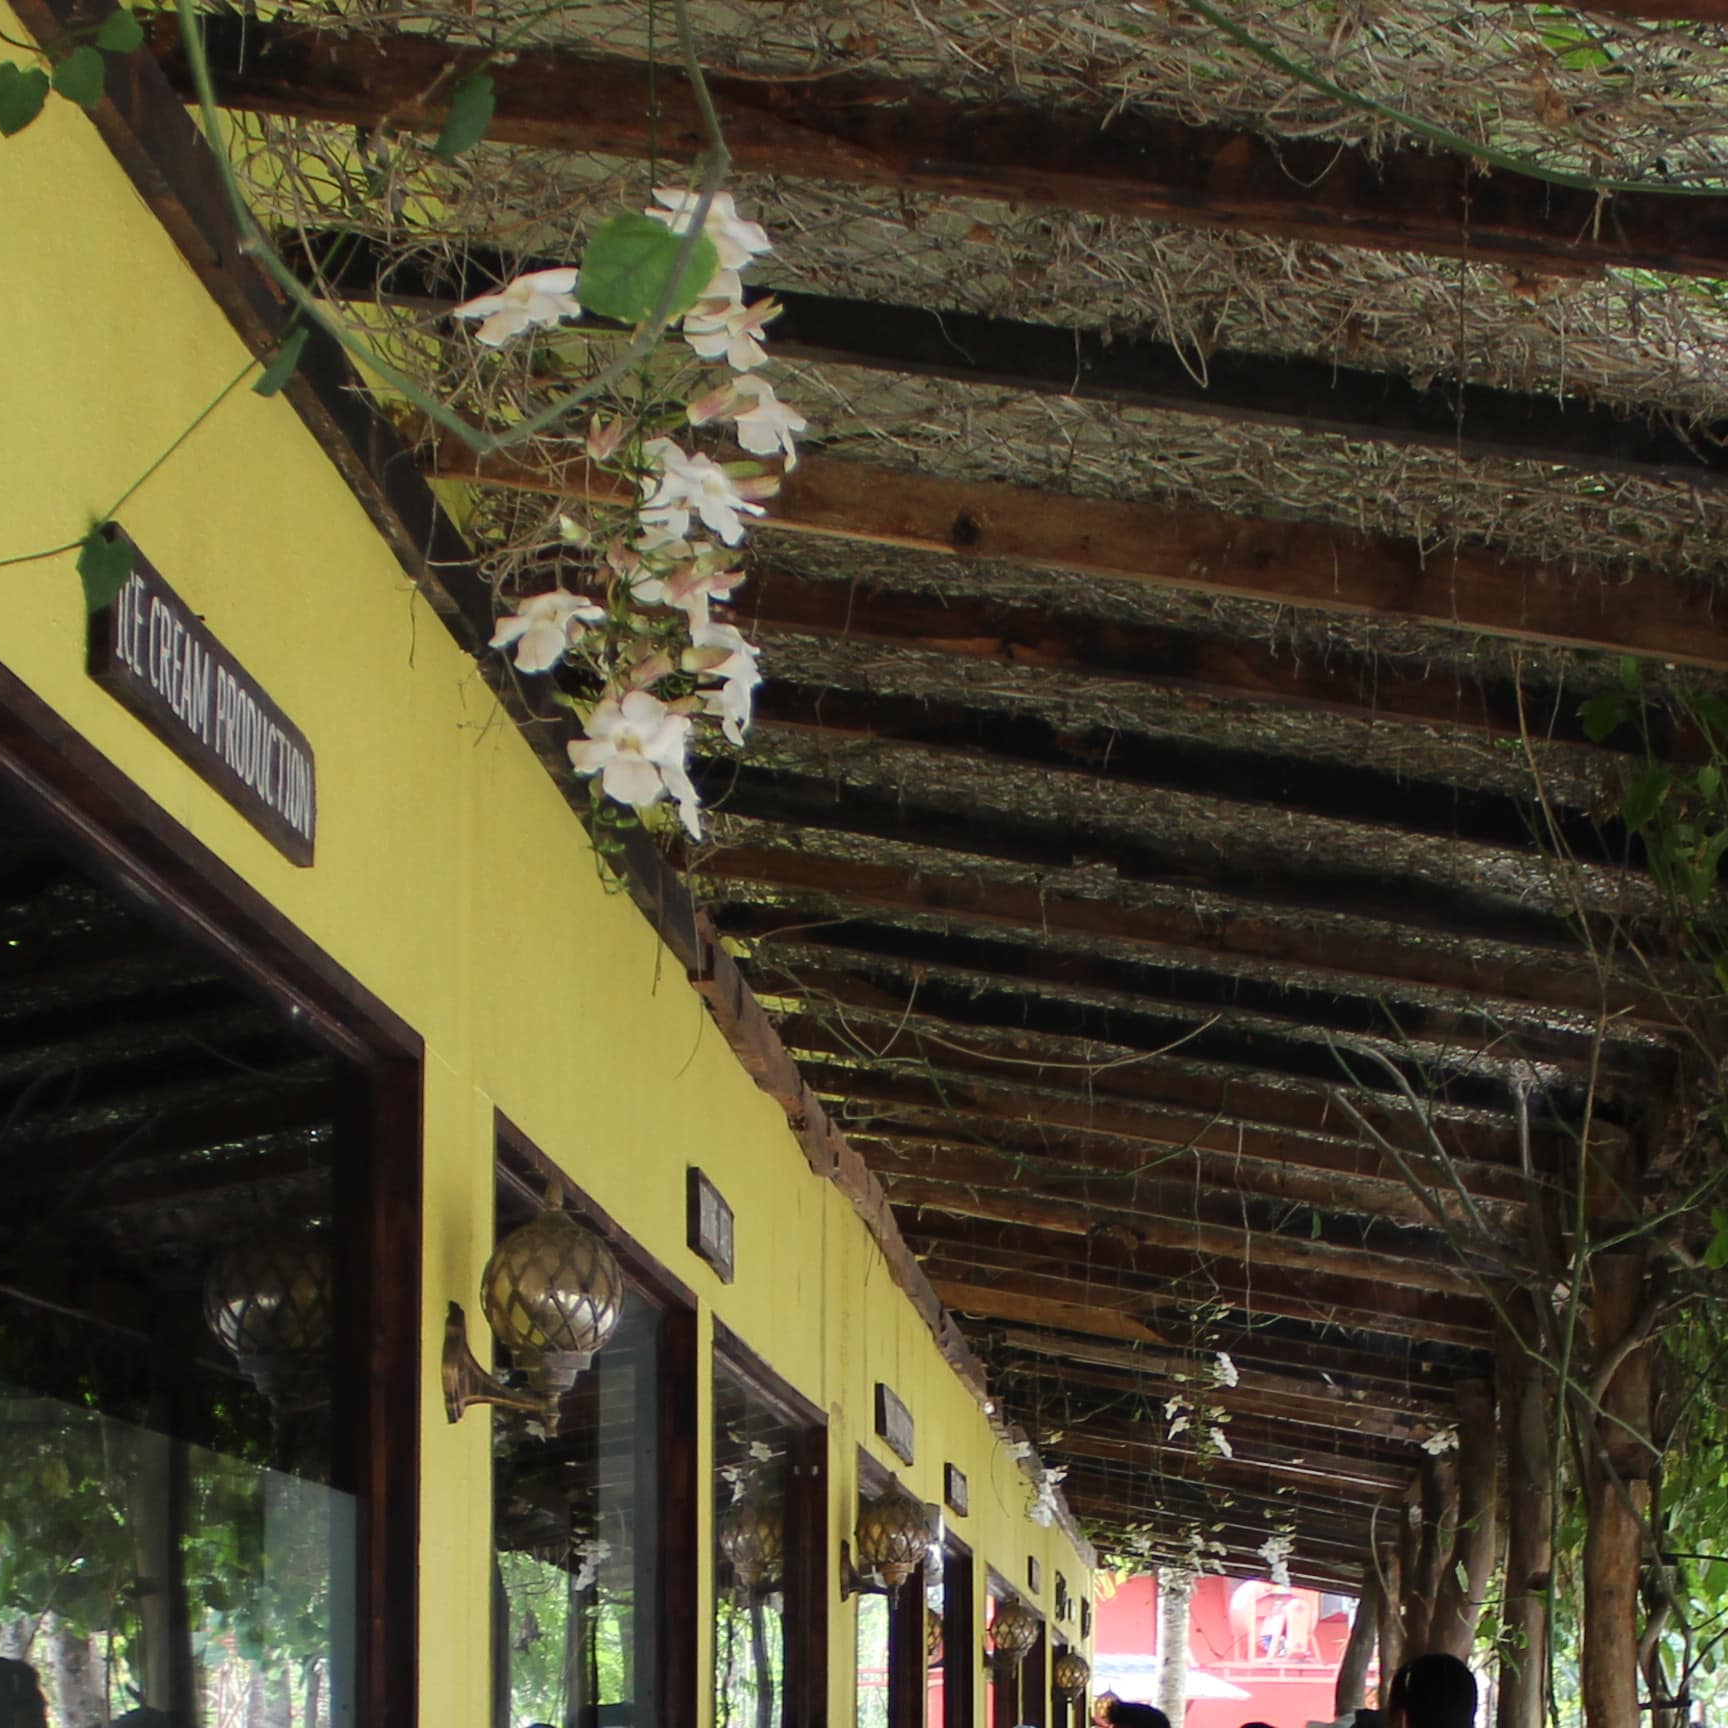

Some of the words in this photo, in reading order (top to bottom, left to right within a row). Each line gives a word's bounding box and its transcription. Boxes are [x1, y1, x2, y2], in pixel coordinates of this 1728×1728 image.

[116, 570, 144, 677] ICE
[149, 596, 210, 744] CREAM
[216, 665, 311, 839] PRODUCTION
